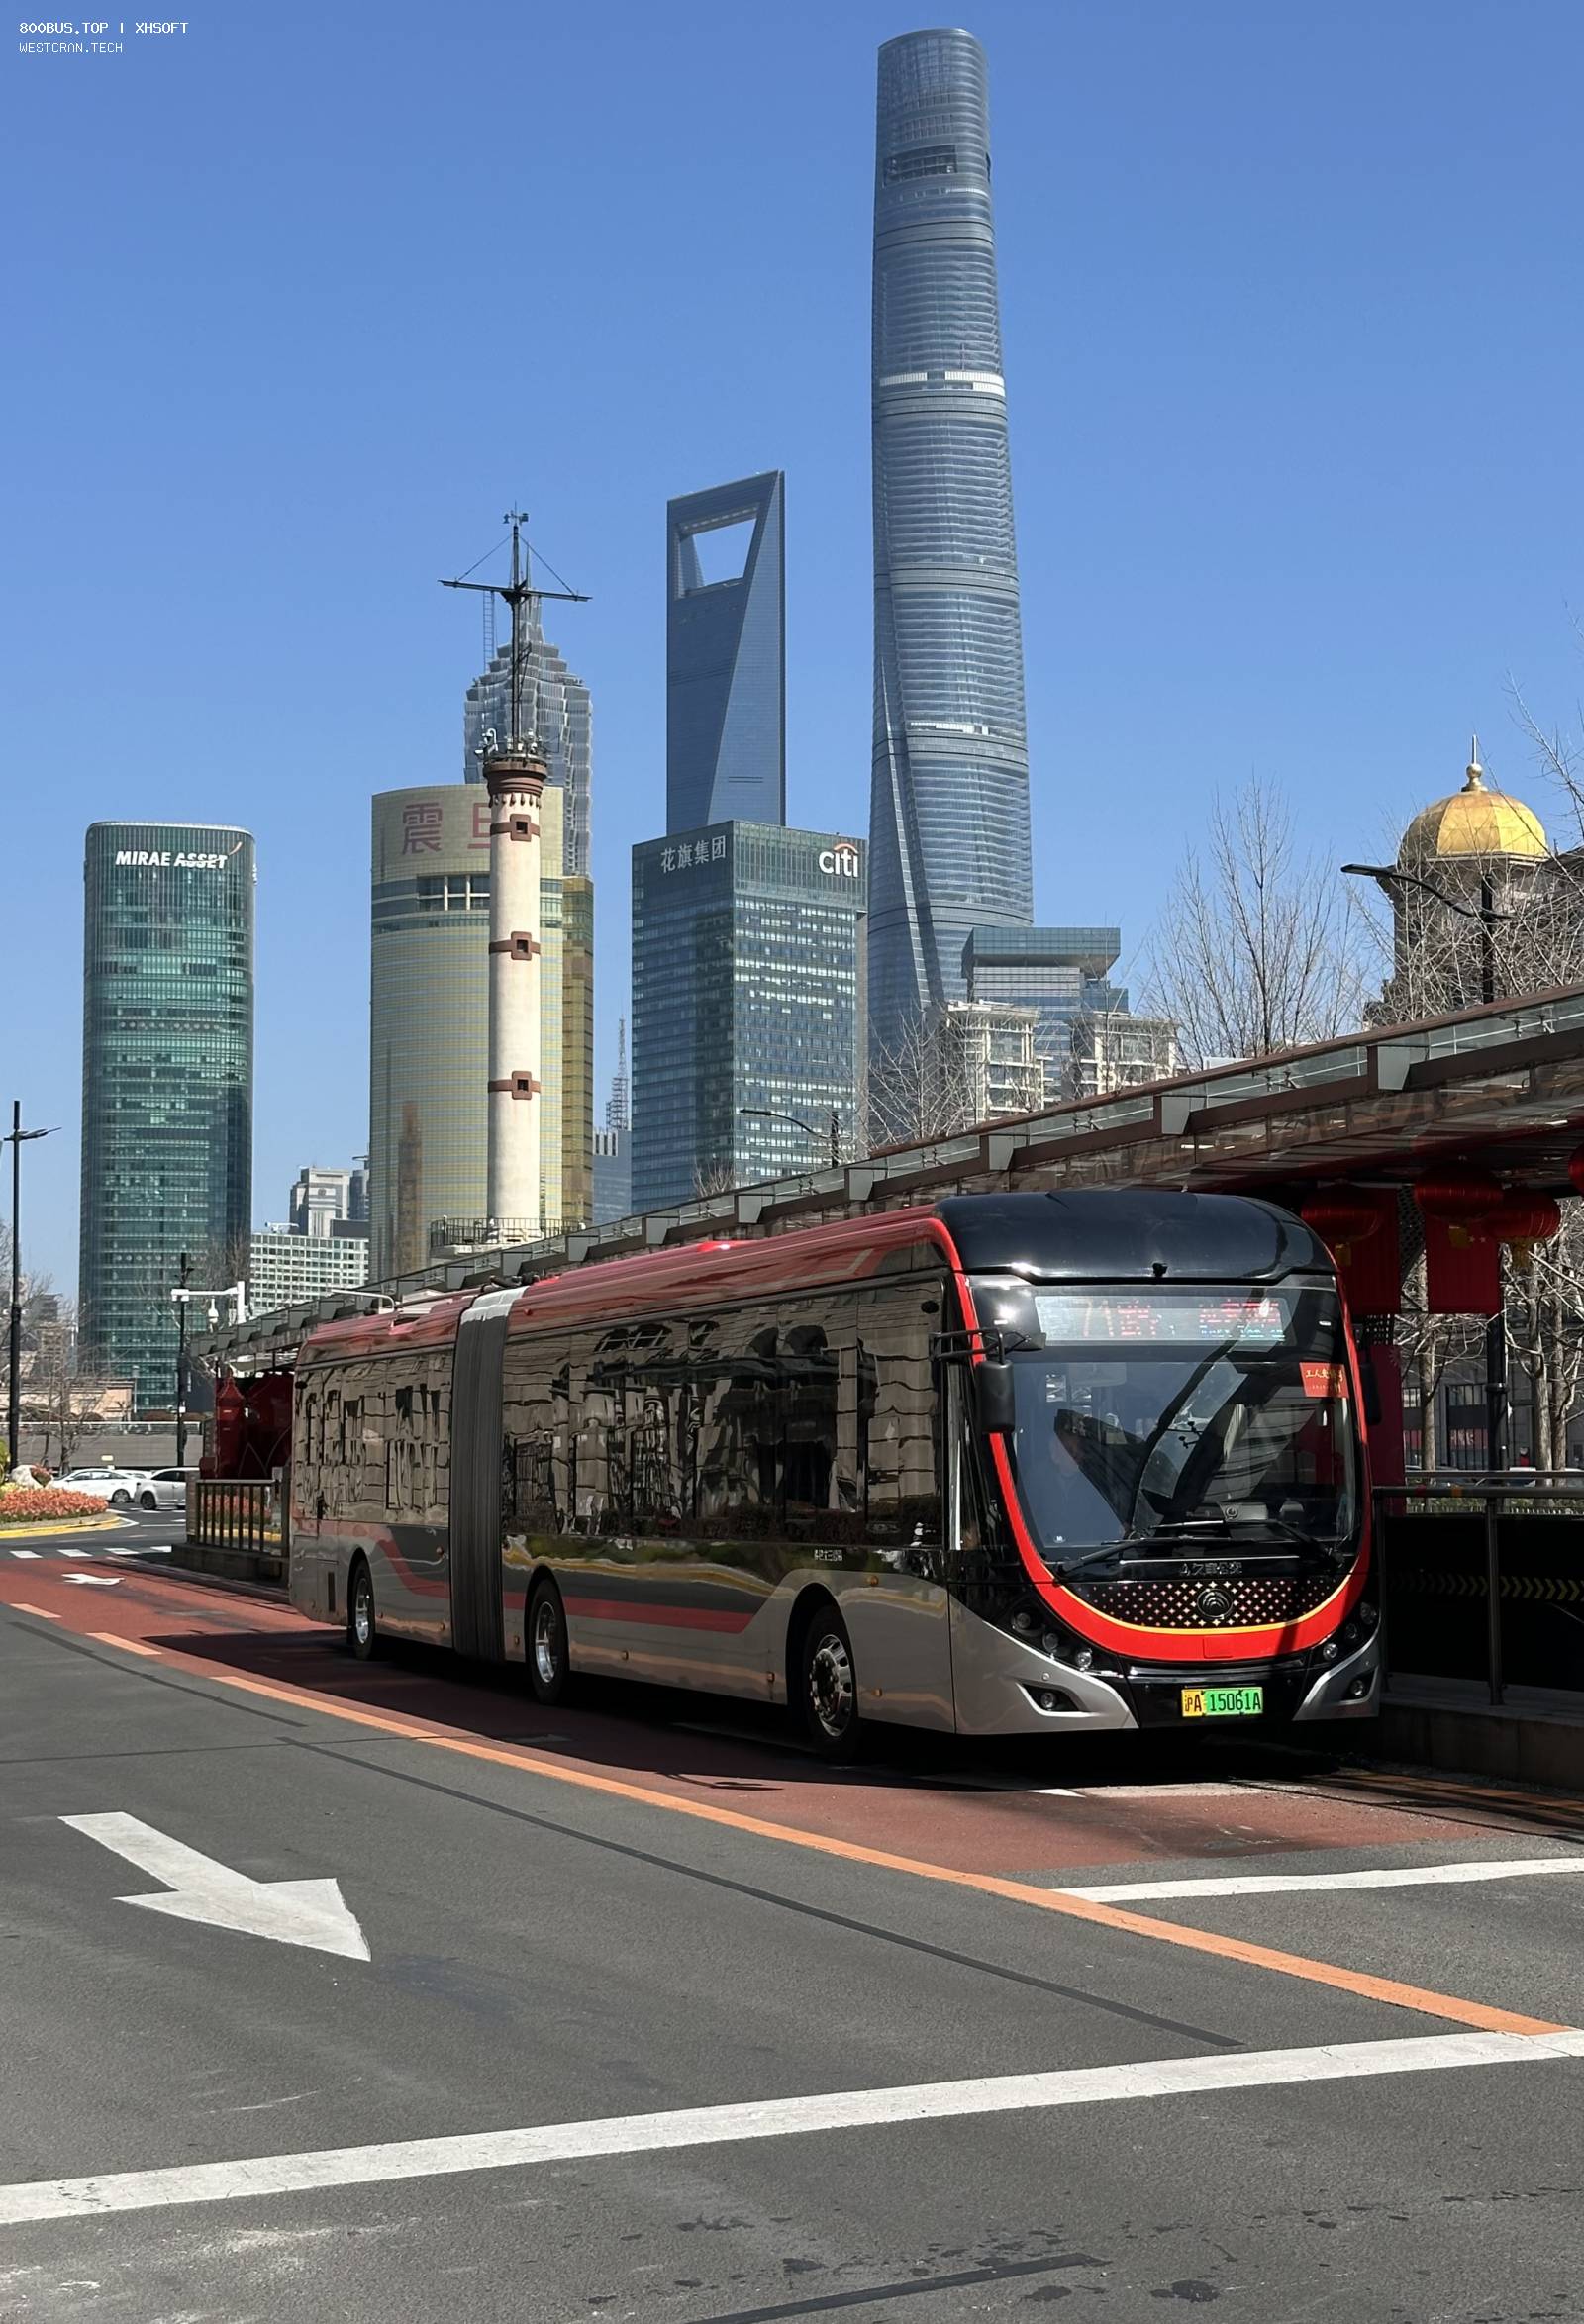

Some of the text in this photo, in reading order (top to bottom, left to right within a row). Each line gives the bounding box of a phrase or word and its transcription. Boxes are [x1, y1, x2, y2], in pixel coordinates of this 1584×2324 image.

[115, 851, 229, 869] MIRAE ASSET
[660, 834, 727, 874] 花旗集团
[818, 843, 859, 878] citi
